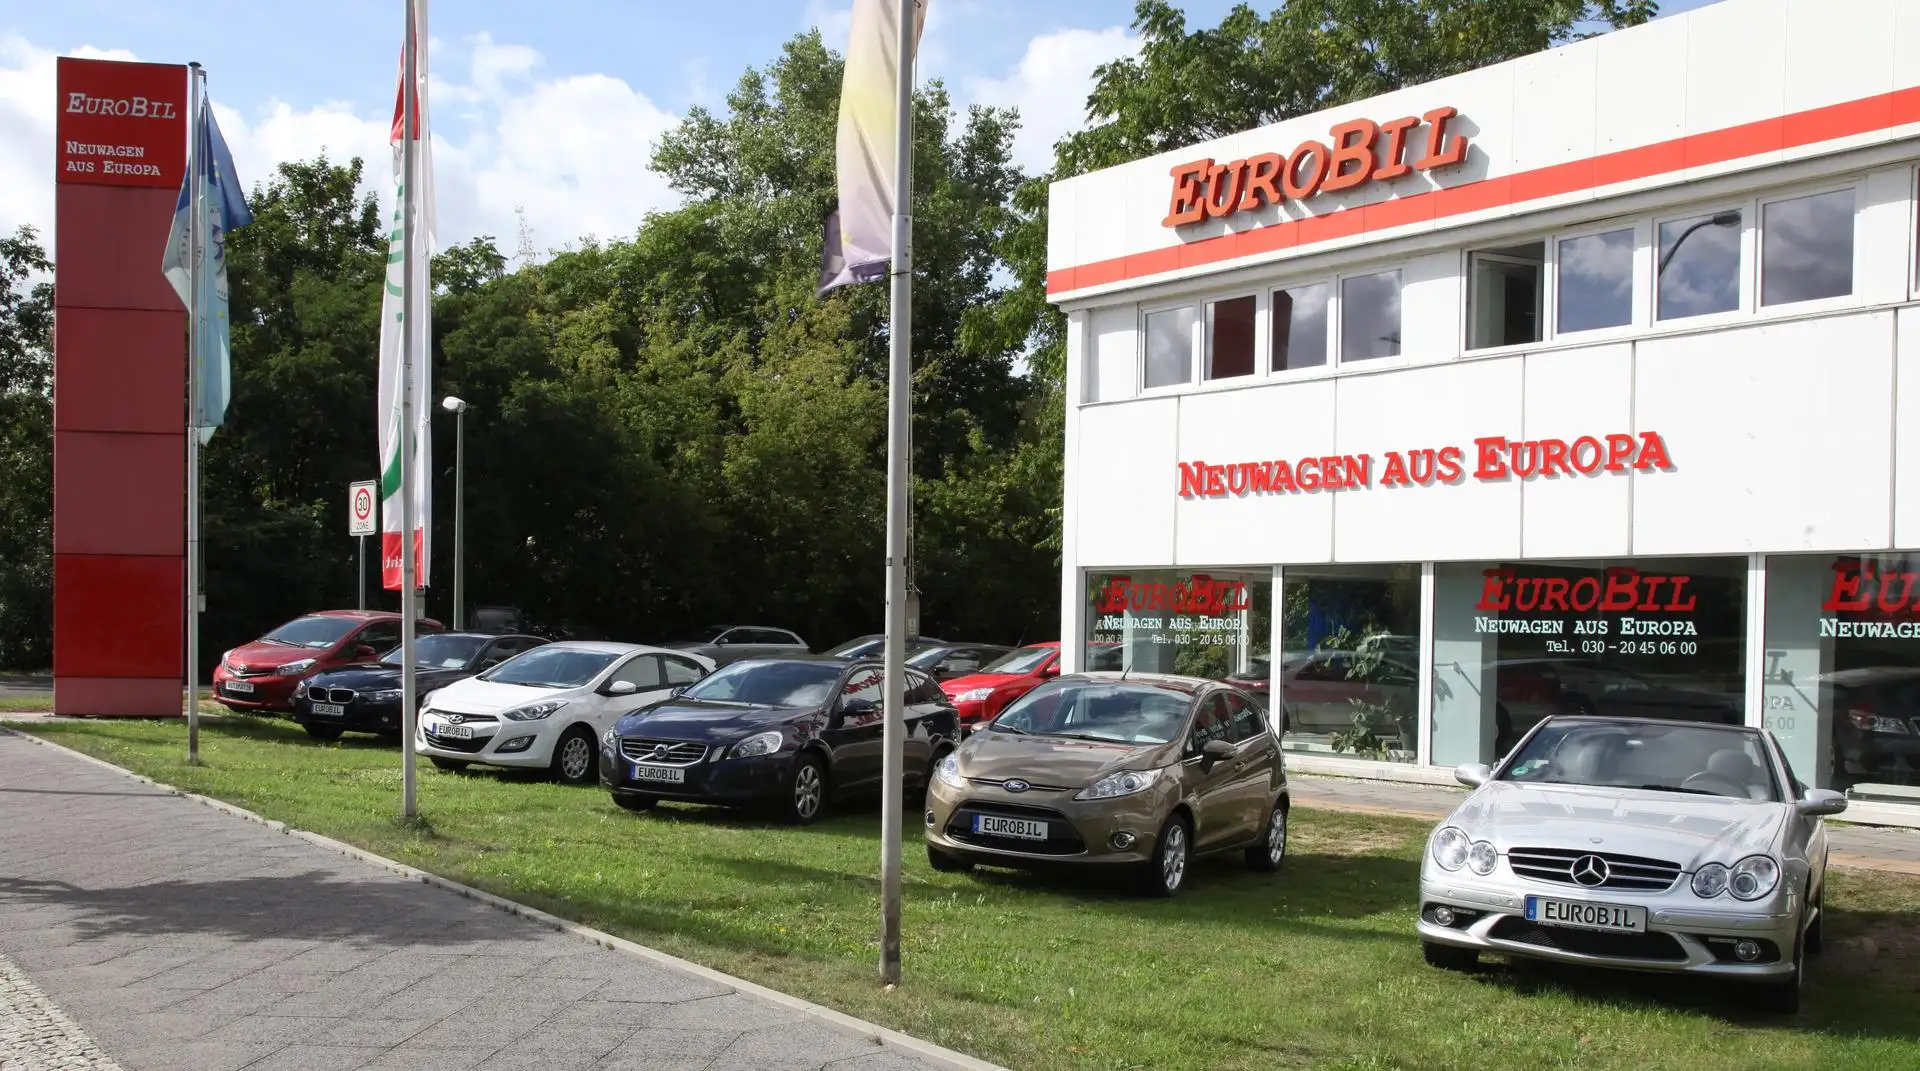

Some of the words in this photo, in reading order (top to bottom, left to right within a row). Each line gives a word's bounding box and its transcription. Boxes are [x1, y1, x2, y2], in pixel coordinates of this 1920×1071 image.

[66, 93, 176, 119] EUROBIL
[66, 141, 144, 157] NEUWAGEN
[66, 161, 95, 172] AUS
[103, 160, 161, 176] EUROPA
[1161, 106, 1469, 228] EUROBIL
[1178, 453, 1371, 498] NEUWAGEN
[1380, 446, 1463, 487] AUS
[1473, 431, 1675, 480] EUROPA
[358, 497, 368, 511] 30
[356, 522, 369, 530] ZONE
[1475, 567, 1697, 612] EUROBIL
[1104, 615, 1163, 629] NEUWAGEN
[1169, 618, 1193, 630] AUS
[1474, 616, 1563, 634] NEUWAGEN
[1574, 620, 1608, 635] AUS
[1620, 617, 1698, 636] EUROPA
[1151, 633, 1171, 645] Tel.
[1546, 640, 1575, 653] Tel.
[1581, 640, 1605, 653] 030
[1620, 640, 1636, 654] 20
[1639, 641, 1656, 654] 45
[1659, 641, 1676, 655] 06
[1680, 641, 1698, 655] 00
[439, 725, 469, 737] EUROBIL
[638, 767, 680, 781] EUROBIL
[984, 817, 1042, 836] EUROBIL
[1545, 901, 1636, 928] EUROBIL
